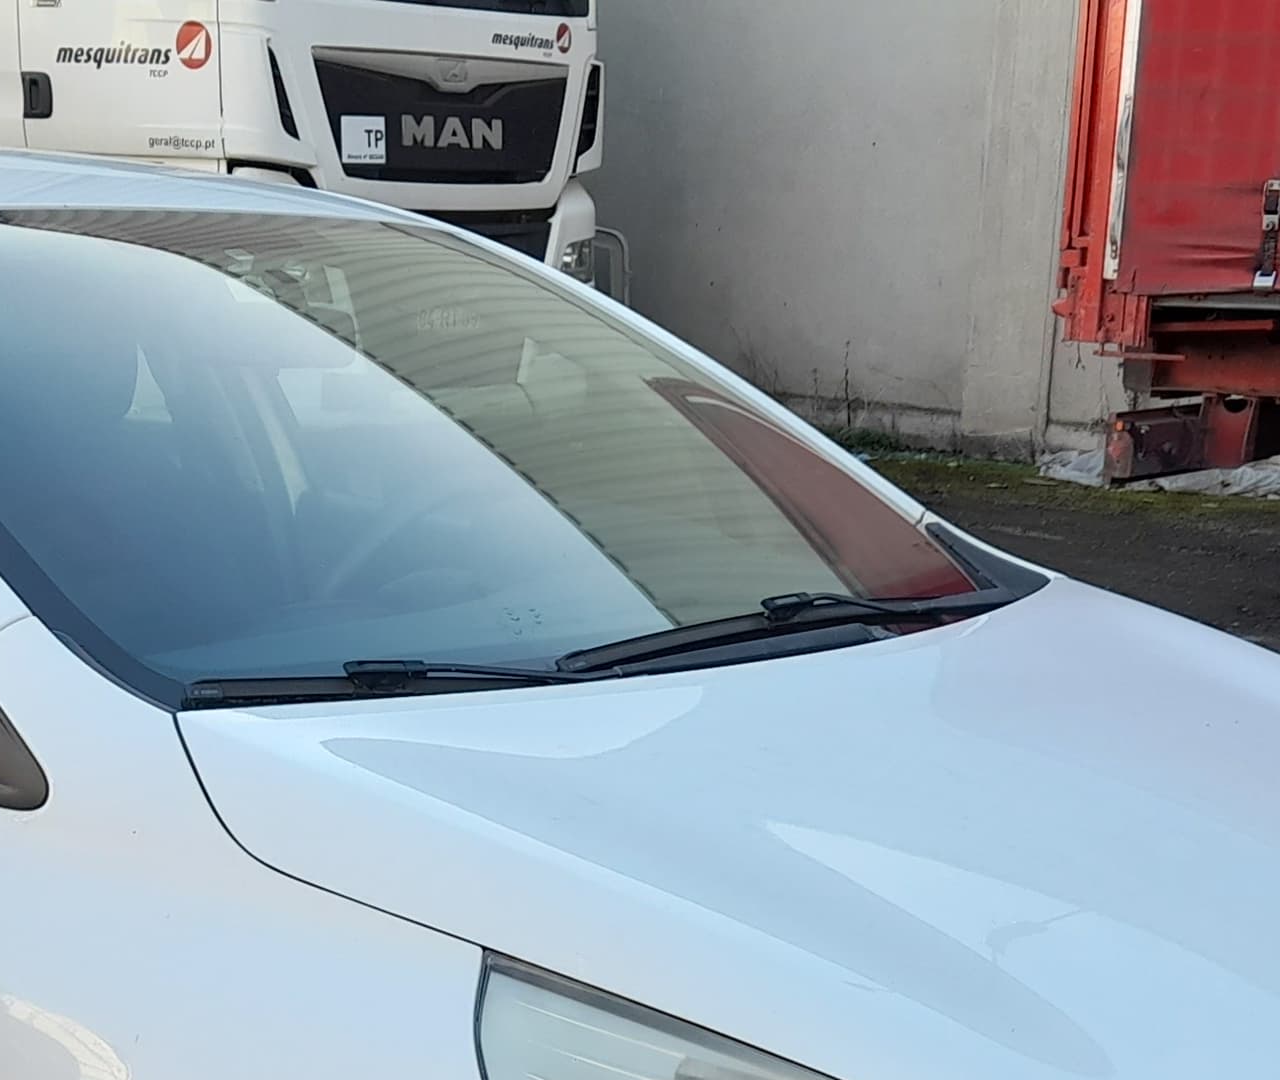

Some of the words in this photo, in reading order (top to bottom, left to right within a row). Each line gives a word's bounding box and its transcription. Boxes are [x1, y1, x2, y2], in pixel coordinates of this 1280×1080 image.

[491, 32, 555, 51] mesquitrans
[56, 40, 172, 70] mesquitrans
[364, 129, 384, 149] TP
[400, 113, 503, 150] MAN
[148, 135, 216, 151] geral@tccp.pt
